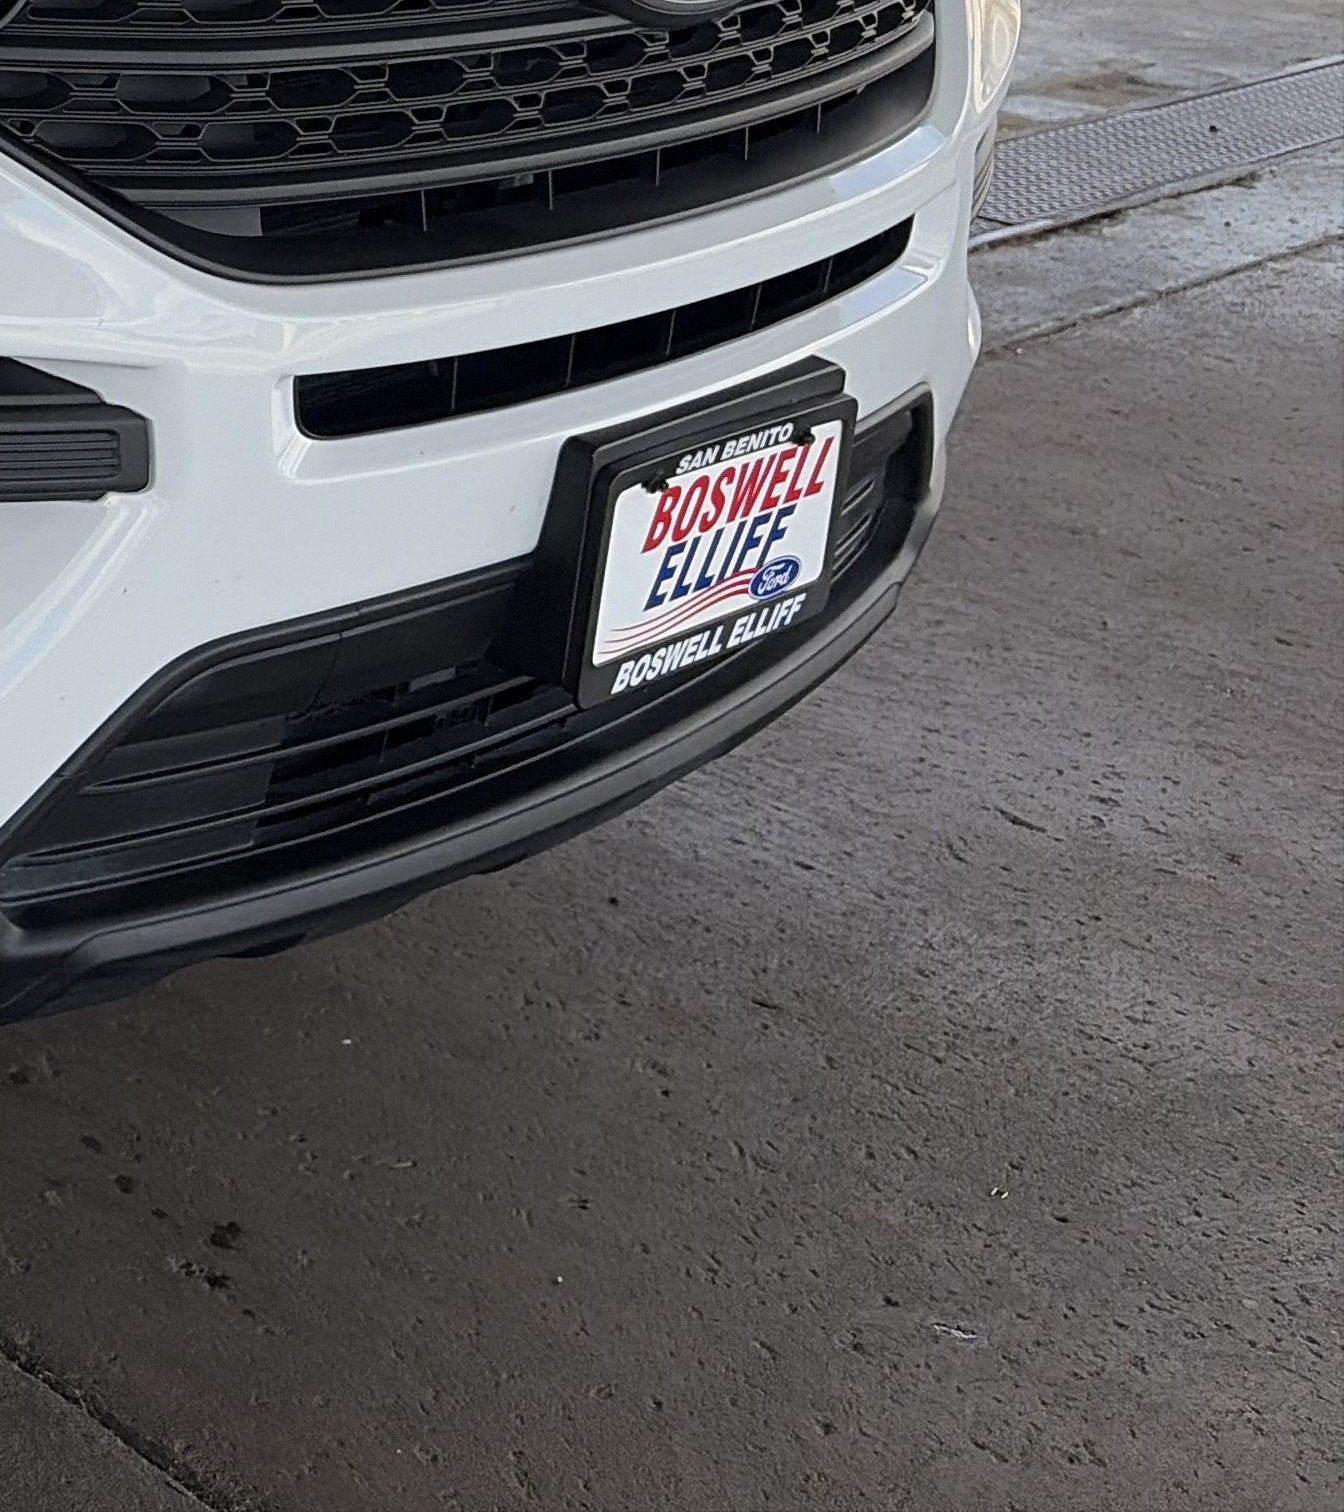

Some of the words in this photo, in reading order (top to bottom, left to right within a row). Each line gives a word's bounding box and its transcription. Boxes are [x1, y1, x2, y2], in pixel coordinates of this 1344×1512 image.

[641, 436, 835, 554] BOSWELL
[675, 445, 719, 475] SAN
[721, 422, 794, 462] BENITO
[644, 504, 798, 612] ELLIFF
[758, 564, 793, 596] Ford
[611, 626, 725, 695] BOSWELL
[729, 593, 807, 646] ELLIFF
